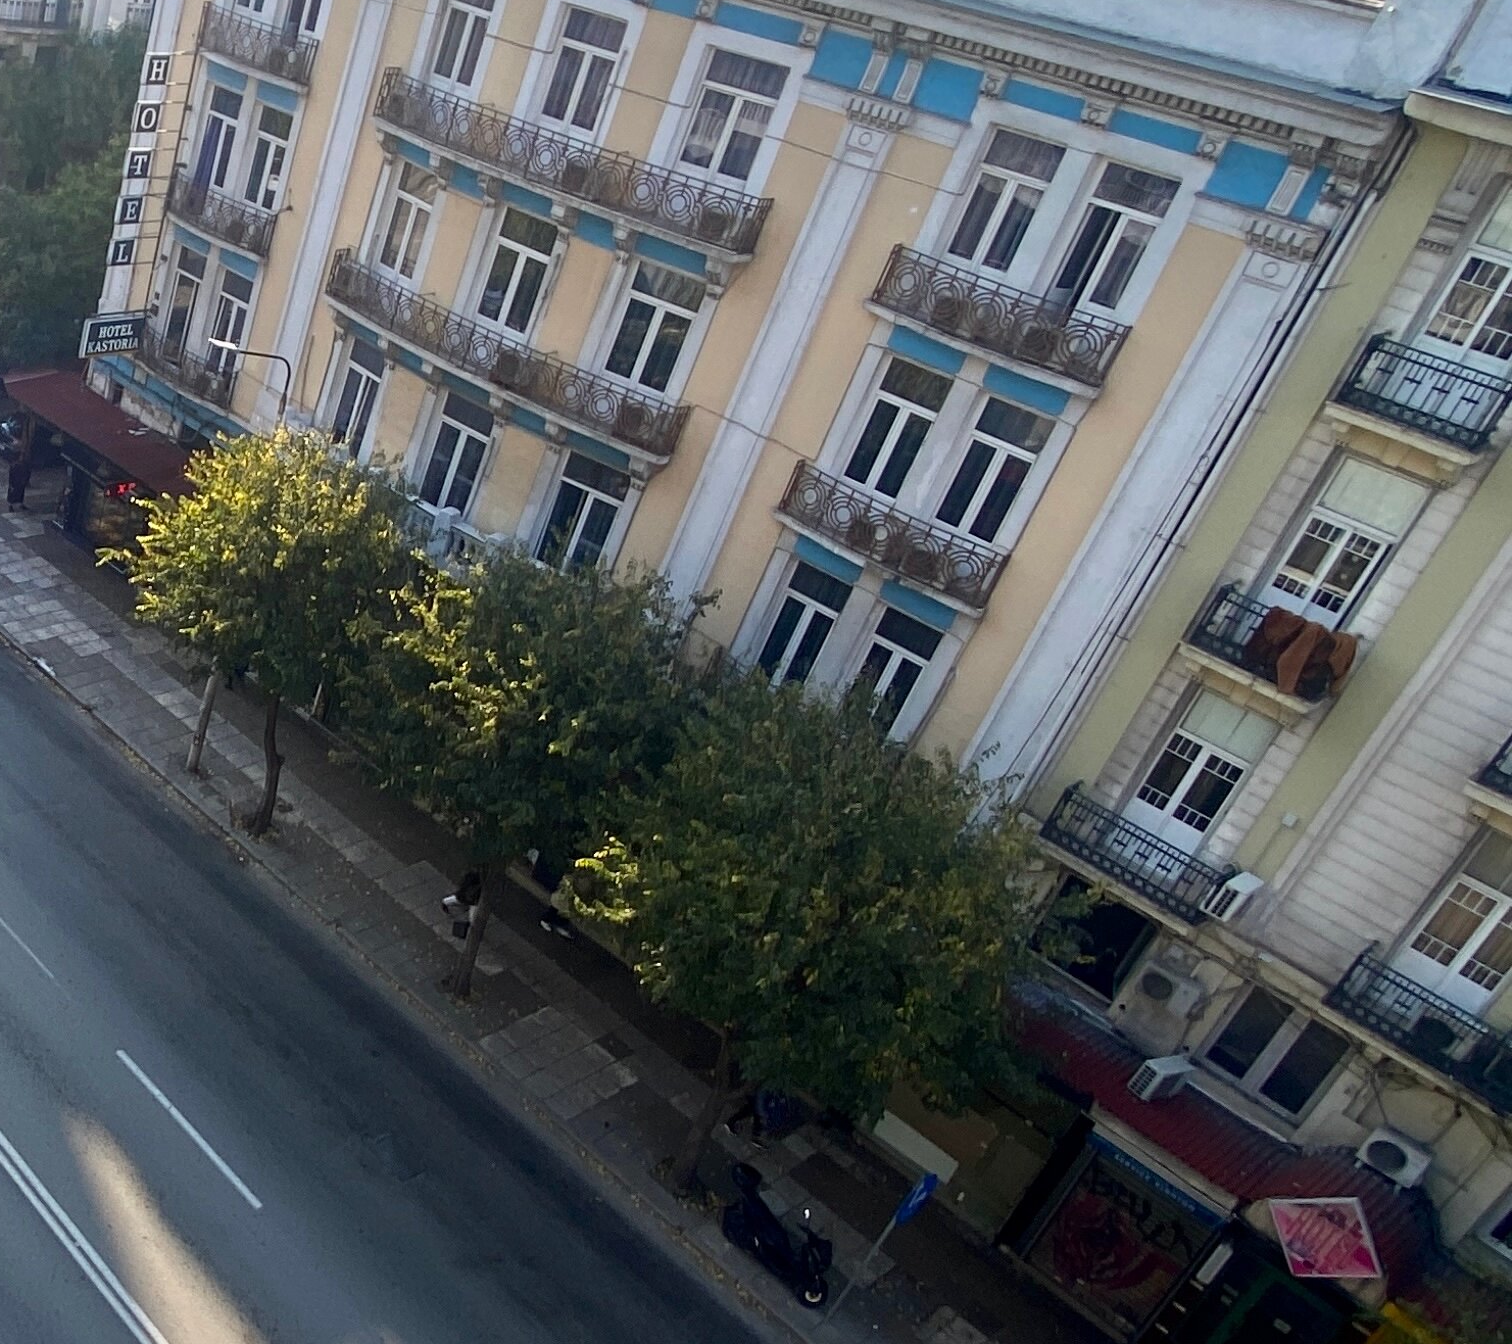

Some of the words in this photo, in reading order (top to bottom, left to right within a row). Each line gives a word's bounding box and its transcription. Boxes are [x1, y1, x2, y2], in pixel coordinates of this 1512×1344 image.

[115, 59, 168, 263] HOTEL
[98, 323, 134, 339] HOTEL
[86, 337, 139, 353] KASTORIA
